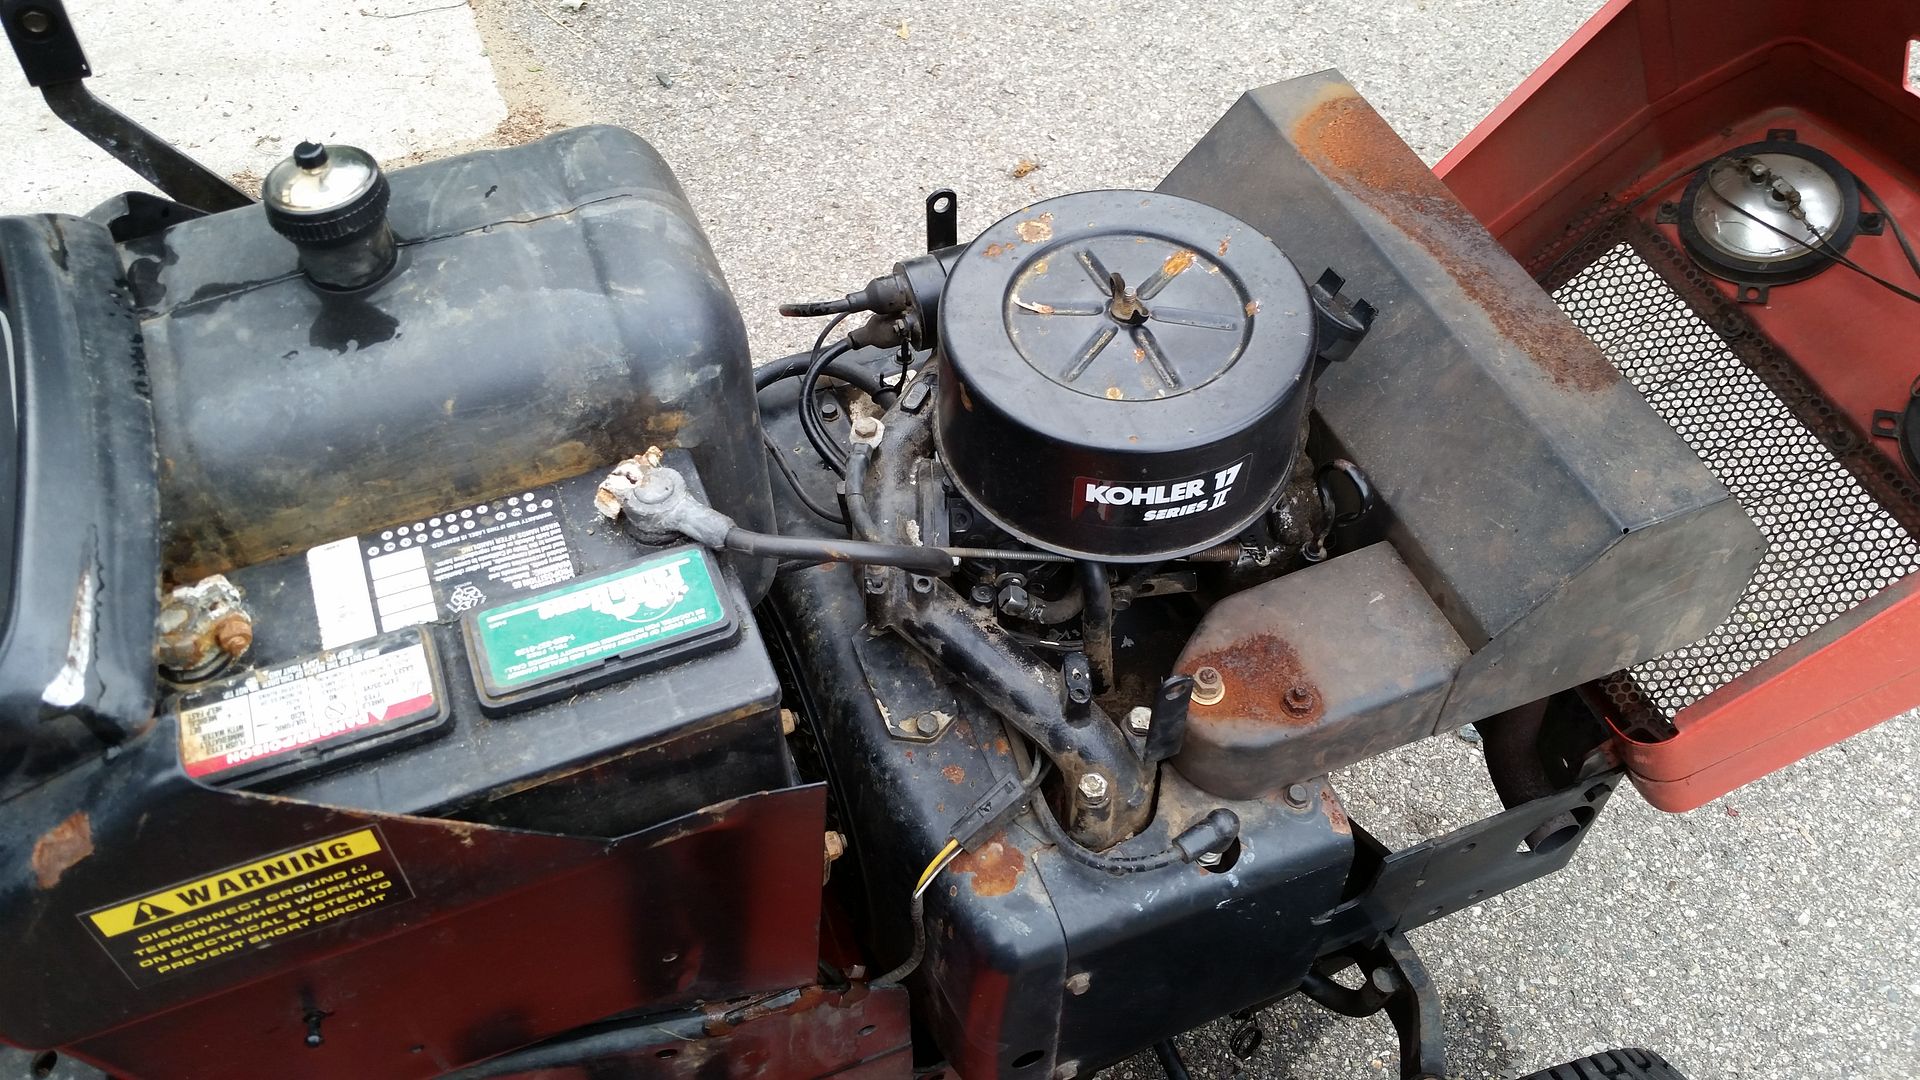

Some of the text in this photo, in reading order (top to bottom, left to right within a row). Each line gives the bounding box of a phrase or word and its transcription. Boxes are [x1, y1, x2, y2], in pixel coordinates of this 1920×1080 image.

[1086, 462, 1243, 505] KOHLER 17
[1143, 487, 1232, 521] SERIES II
[137, 898, 263, 944] DISCONNECT
[265, 869, 348, 903] GROUND
[176, 842, 353, 907] WARNING
[133, 870, 385, 957] TERMINAL WHEN WORKING
[138, 880, 393, 969] ON ELECTRICAL SYSTEM TO
[158, 892, 387, 974] PREVENT SHORT CIRCUIT
